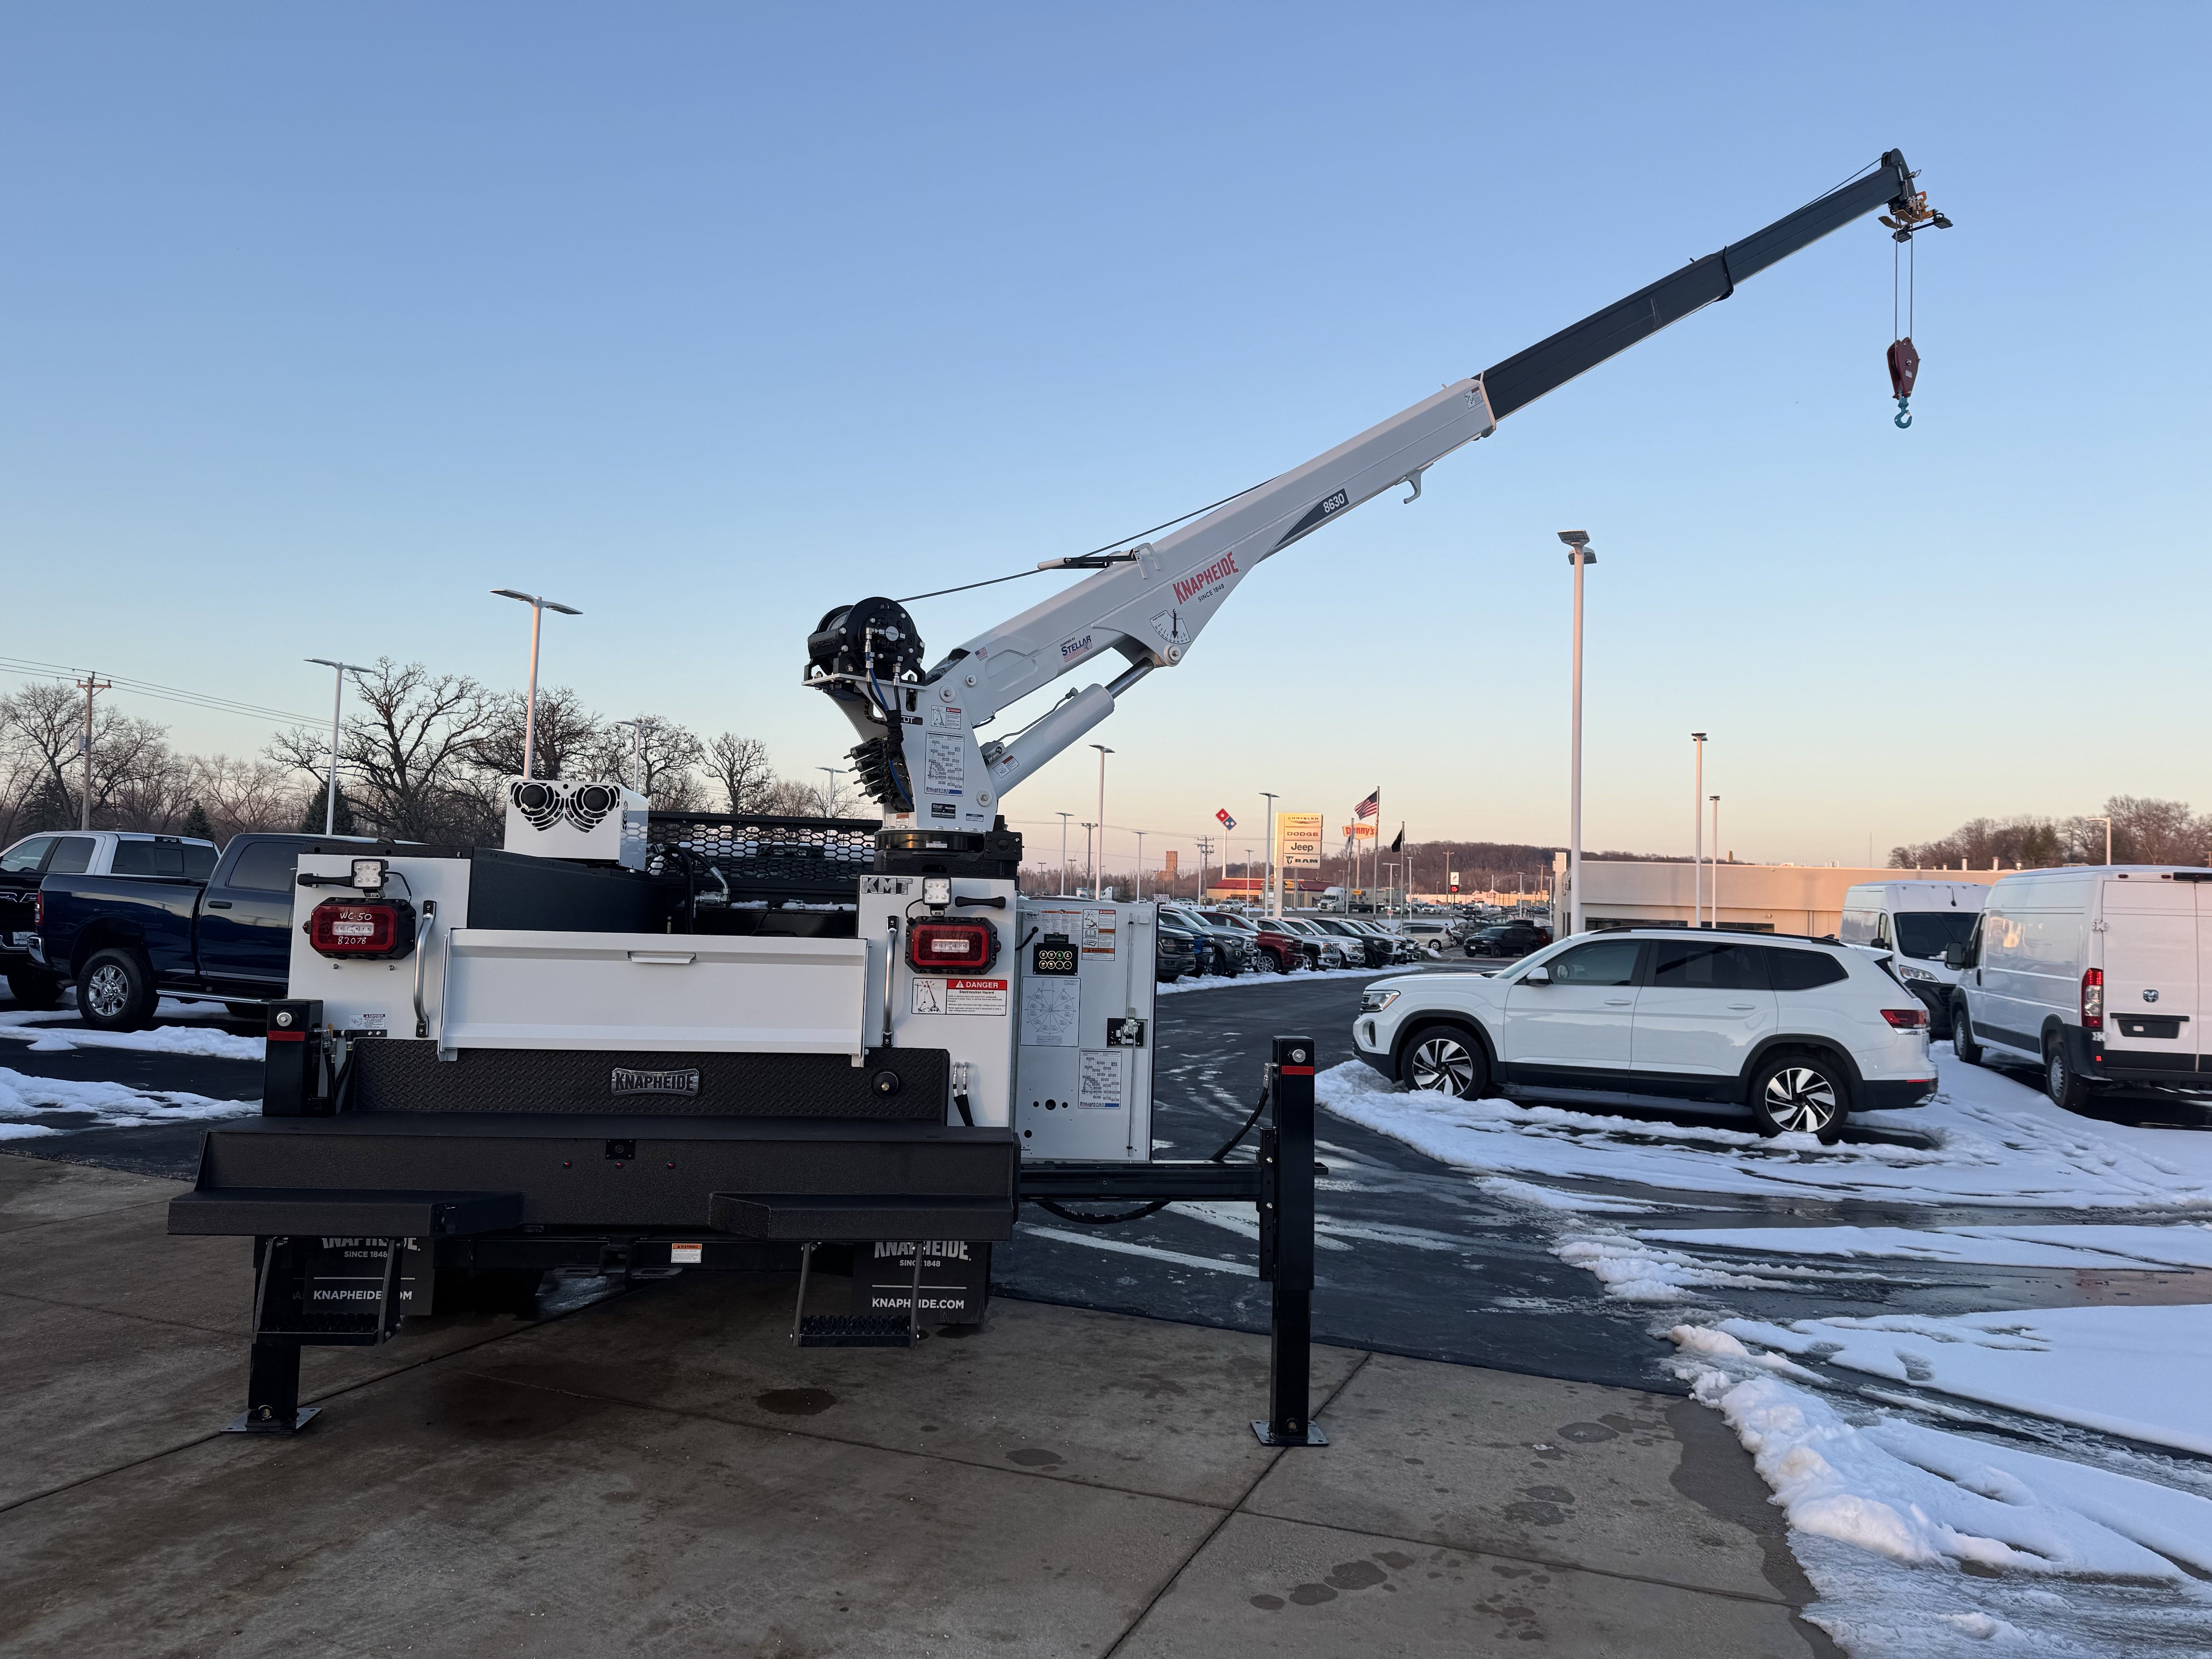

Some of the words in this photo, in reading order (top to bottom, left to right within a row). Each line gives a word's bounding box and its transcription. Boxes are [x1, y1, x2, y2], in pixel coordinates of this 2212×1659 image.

[1323, 493, 1345, 513] 8630
[1198, 590, 1213, 602] SINCE
[1213, 583, 1224, 593] 1848
[1061, 635, 1092, 656] STELLAR
[1345, 826, 1375, 836] Dnny's
[1291, 842, 1314, 852] Jeep
[861, 877, 913, 895] KMT
[338, 936, 367, 945] 82078
[615, 1072, 695, 1092] KNAPHEIDE
[872, 1298, 964, 1309] KNAPHIDE.COM
